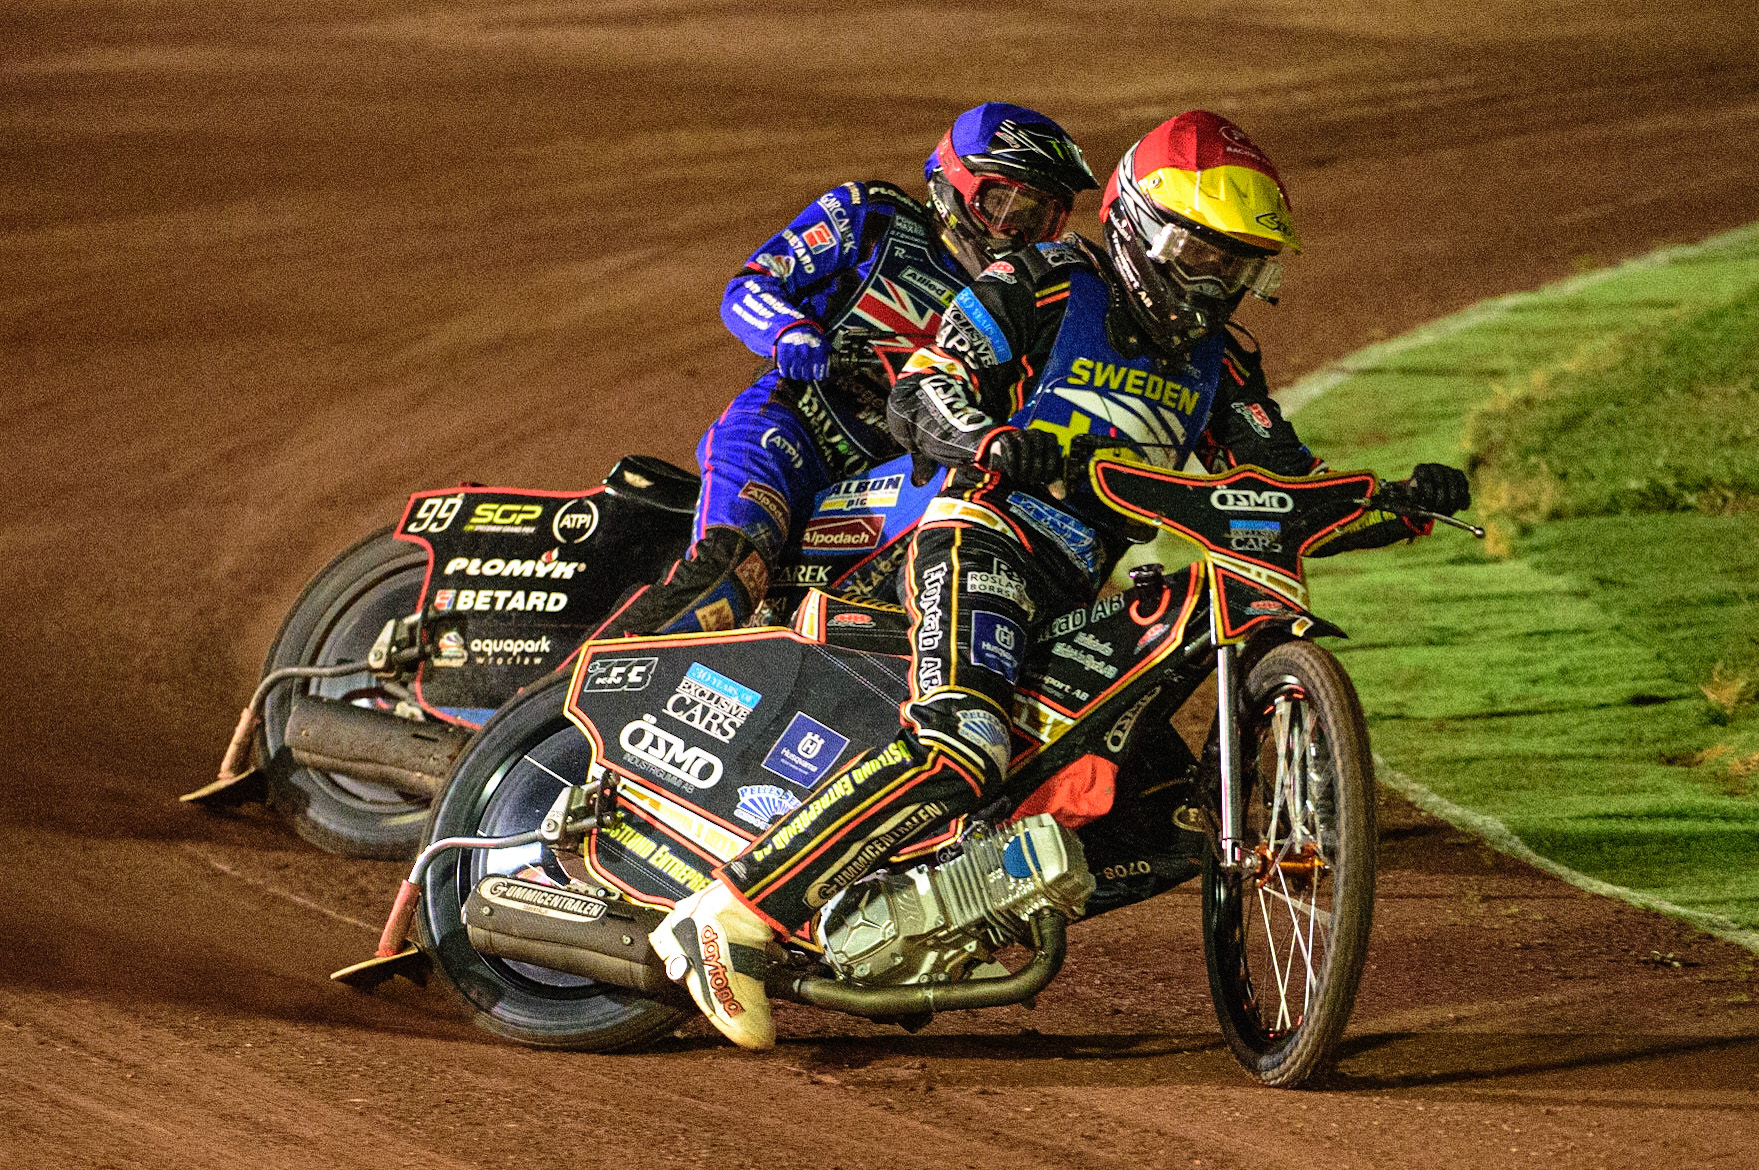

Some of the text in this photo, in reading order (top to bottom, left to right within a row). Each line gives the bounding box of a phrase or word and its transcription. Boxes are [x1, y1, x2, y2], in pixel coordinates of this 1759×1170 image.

[782, 229, 816, 274] BETARD
[1067, 357, 1200, 416] SWEDEN
[828, 476, 902, 497] ALBON
[407, 497, 463, 533] 99
[469, 503, 543, 525] SGP
[560, 514, 591, 529] ATPI
[803, 531, 869, 546] Alpodach
[456, 590, 568, 612] BETARD
[470, 635, 551, 656] aquapark
[665, 692, 742, 741] CARS
[677, 678, 752, 721] EXCLUSIVE
[619, 713, 724, 789] ÖSMO
[490, 881, 603, 917] GUMMICENTRALEN
[700, 925, 745, 1018] daytona
